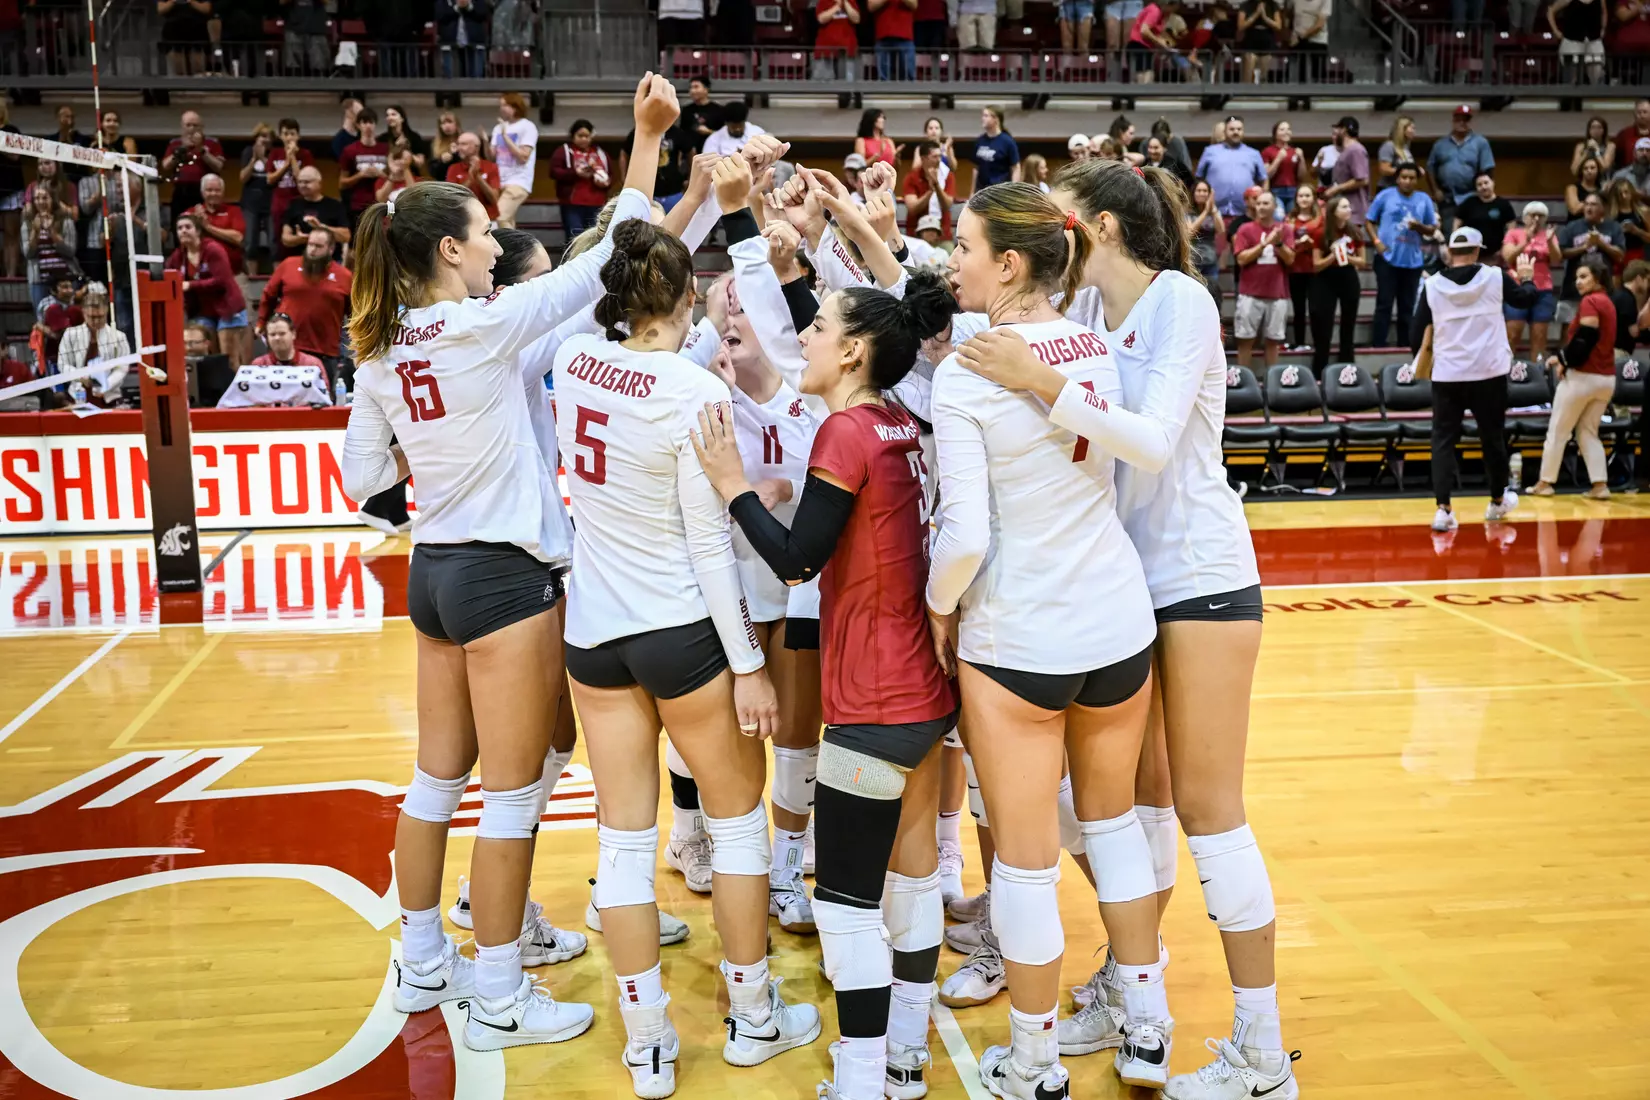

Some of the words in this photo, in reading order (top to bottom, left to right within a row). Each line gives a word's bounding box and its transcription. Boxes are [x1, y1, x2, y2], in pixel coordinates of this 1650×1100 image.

[831, 240, 864, 283] COUGARS
[394, 359, 447, 422] 15
[566, 352, 657, 399] COUGARS
[1083, 391, 1109, 414] WSU
[573, 404, 610, 485] 5
[761, 425, 783, 465] 11
[1433, 589, 1640, 607] Court
